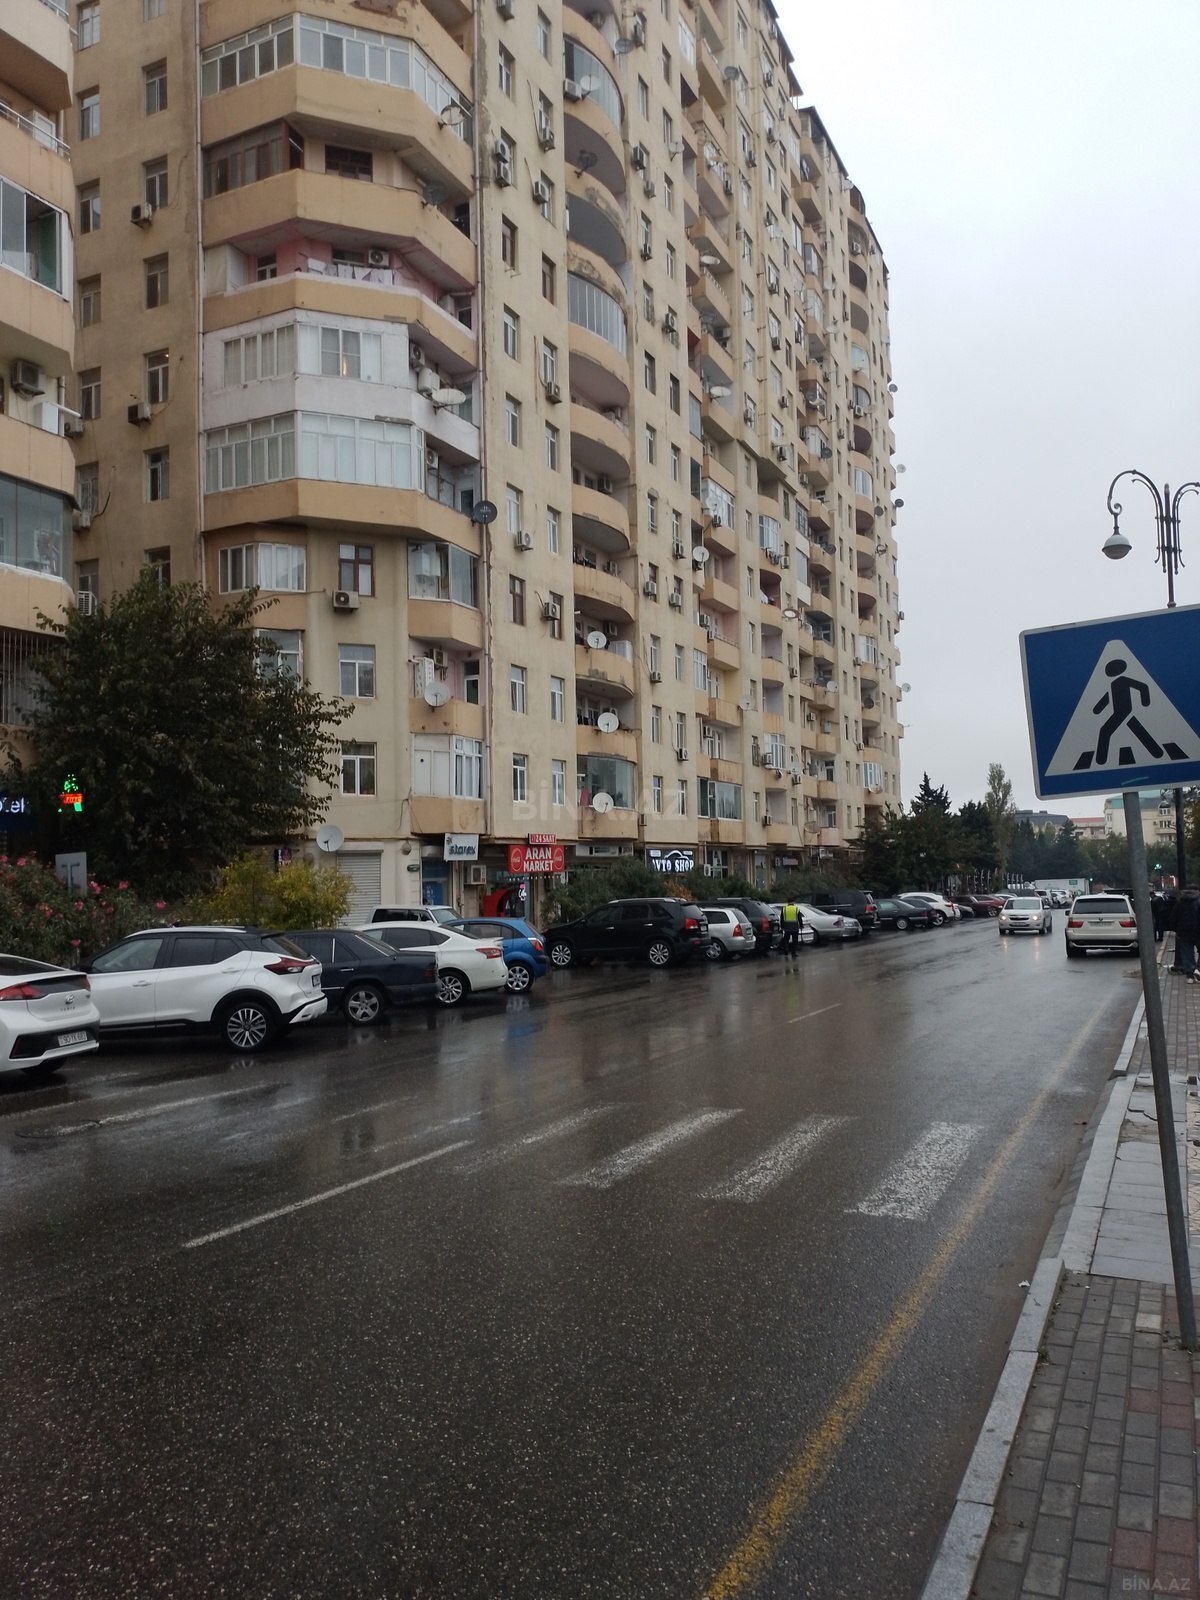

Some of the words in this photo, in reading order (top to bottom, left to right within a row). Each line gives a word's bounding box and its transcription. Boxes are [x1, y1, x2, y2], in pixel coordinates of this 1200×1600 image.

[543, 834, 555, 843] SAAT
[525, 846, 552, 860] ARAN
[523, 860, 554, 872] MARKET
[674, 859, 694, 872] SHOP
